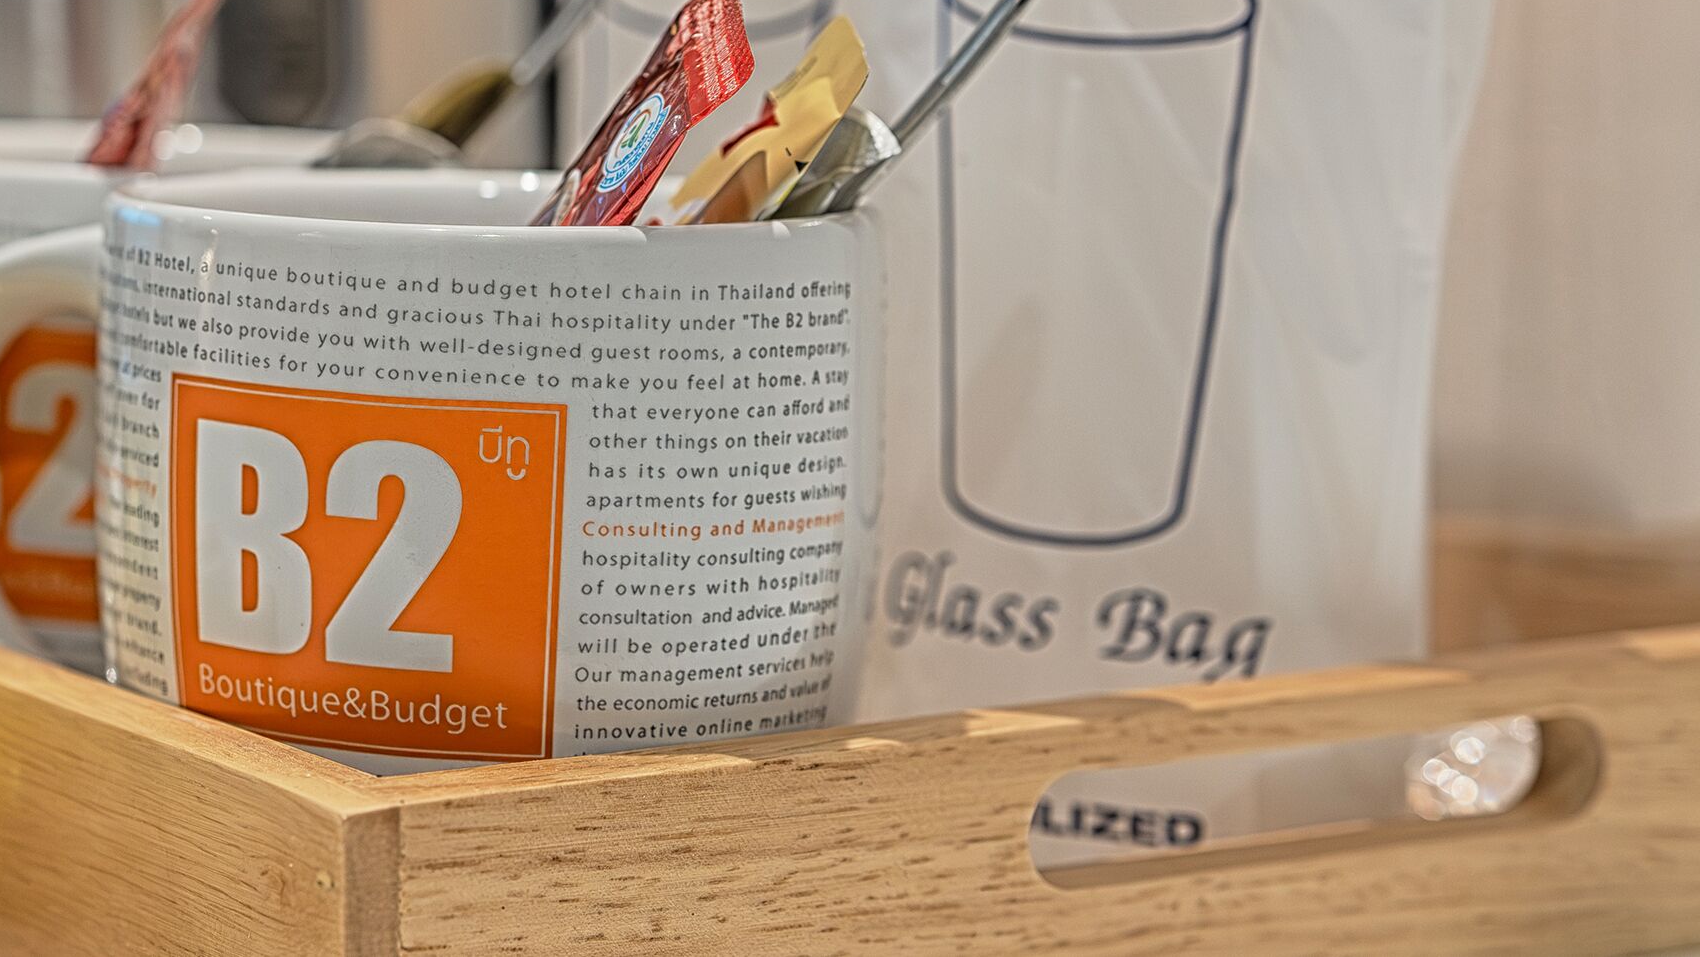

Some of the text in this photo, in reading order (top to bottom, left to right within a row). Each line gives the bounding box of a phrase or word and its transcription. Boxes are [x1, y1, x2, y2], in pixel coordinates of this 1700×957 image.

[155, 251, 195, 274] Hotel,
[200, 262, 210, 273] a
[216, 262, 278, 282] unique
[287, 267, 386, 291] boutique
[397, 277, 439, 292] and
[452, 278, 538, 299] budget
[550, 282, 611, 299] hotel
[622, 284, 681, 300] chain
[691, 285, 709, 300] in
[717, 282, 795, 300] Thailand
[801, 280, 851, 300] offering
[143, 281, 231, 306] international
[236, 294, 330, 316] standards
[339, 304, 377, 319] and
[387, 308, 484, 325] gracious
[493, 309, 541, 327] Thai
[552, 313, 671, 334] hospitality
[680, 315, 736, 331] under
[743, 313, 780, 329] "The
[786, 312, 803, 329] B2
[153, 310, 173, 328] but
[178, 316, 197, 331] we
[202, 318, 233, 336] also
[239, 322, 310, 343] provide
[318, 333, 354, 349] you
[364, 335, 410, 351] with
[420, 338, 581, 360] well-designed
[591, 345, 651, 363] guest
[659, 348, 725, 362] rooms,
[732, 348, 742, 359] a
[133, 363, 162, 383] prices
[194, 344, 270, 369] facilities
[279, 355, 308, 373] for
[317, 362, 365, 377] your
[375, 367, 525, 386] convenience
[538, 373, 559, 387] to
[571, 374, 629, 390] make
[640, 377, 678, 393] you
[687, 374, 725, 390] feel
[732, 376, 750, 389] at
[758, 372, 807, 388] home.
[811, 370, 820, 385] A
[825, 369, 849, 386] stay
[142, 393, 160, 411] for
[592, 394, 849, 424] that everyone can afford and
[589, 425, 849, 453] other things on their vacation
[589, 455, 847, 479] has its own unique design.
[586, 483, 847, 511] apartments for guests wishing
[582, 511, 845, 541] Consulting and Management
[196, 417, 463, 673] B2
[582, 541, 843, 571] hospitality consulting company
[581, 568, 841, 596] of owners with hospitality
[579, 609, 692, 625] consultation
[702, 607, 732, 624] and
[736, 604, 786, 622] advice.
[883, 549, 1273, 682] Glass Bag
[578, 621, 836, 657] will be operated under the
[575, 648, 835, 686] Our management services help
[199, 662, 508, 735] Boutique&Budget
[577, 695, 607, 711] the
[613, 694, 699, 711] economic
[704, 688, 757, 708] returns
[762, 684, 787, 702] and
[575, 705, 829, 740] innovative online marketing
[1032, 799, 1205, 846] LIZED
